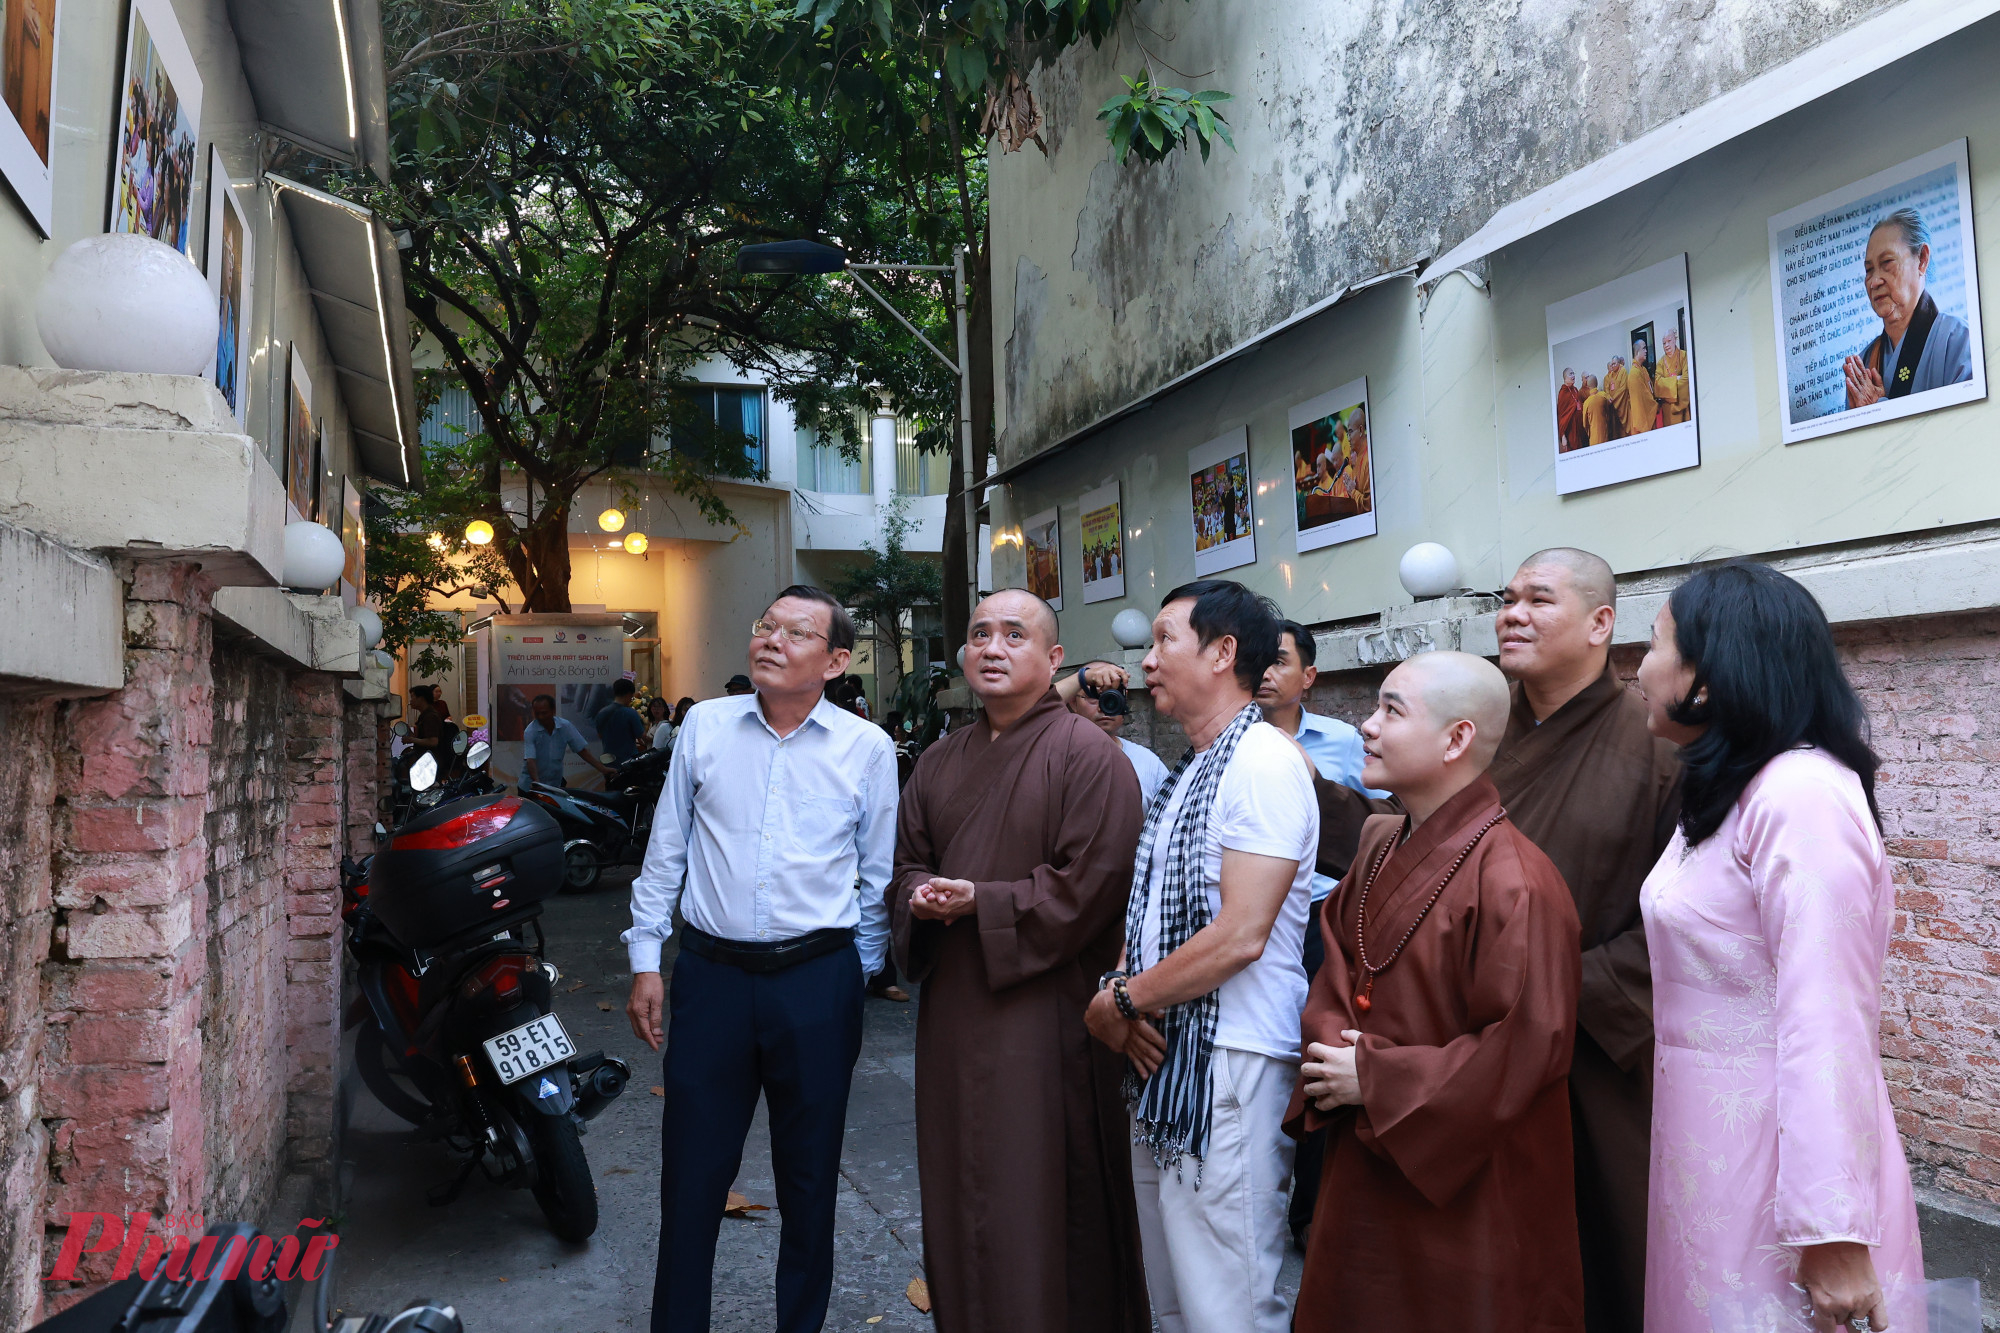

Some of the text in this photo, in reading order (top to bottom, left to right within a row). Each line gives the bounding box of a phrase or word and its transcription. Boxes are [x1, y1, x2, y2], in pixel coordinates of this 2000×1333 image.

[1828, 231, 1840, 241] NAM
[1836, 241, 1854, 254] TRANG
[1786, 276, 1797, 287] CHO
[1795, 385, 1805, 393] BAN
[532, 666, 556, 678] sáng
[558, 666, 566, 675] &
[568, 665, 595, 678] Bóng
[495, 1021, 550, 1057] 59-E1
[499, 1036, 570, 1079] 918.15
